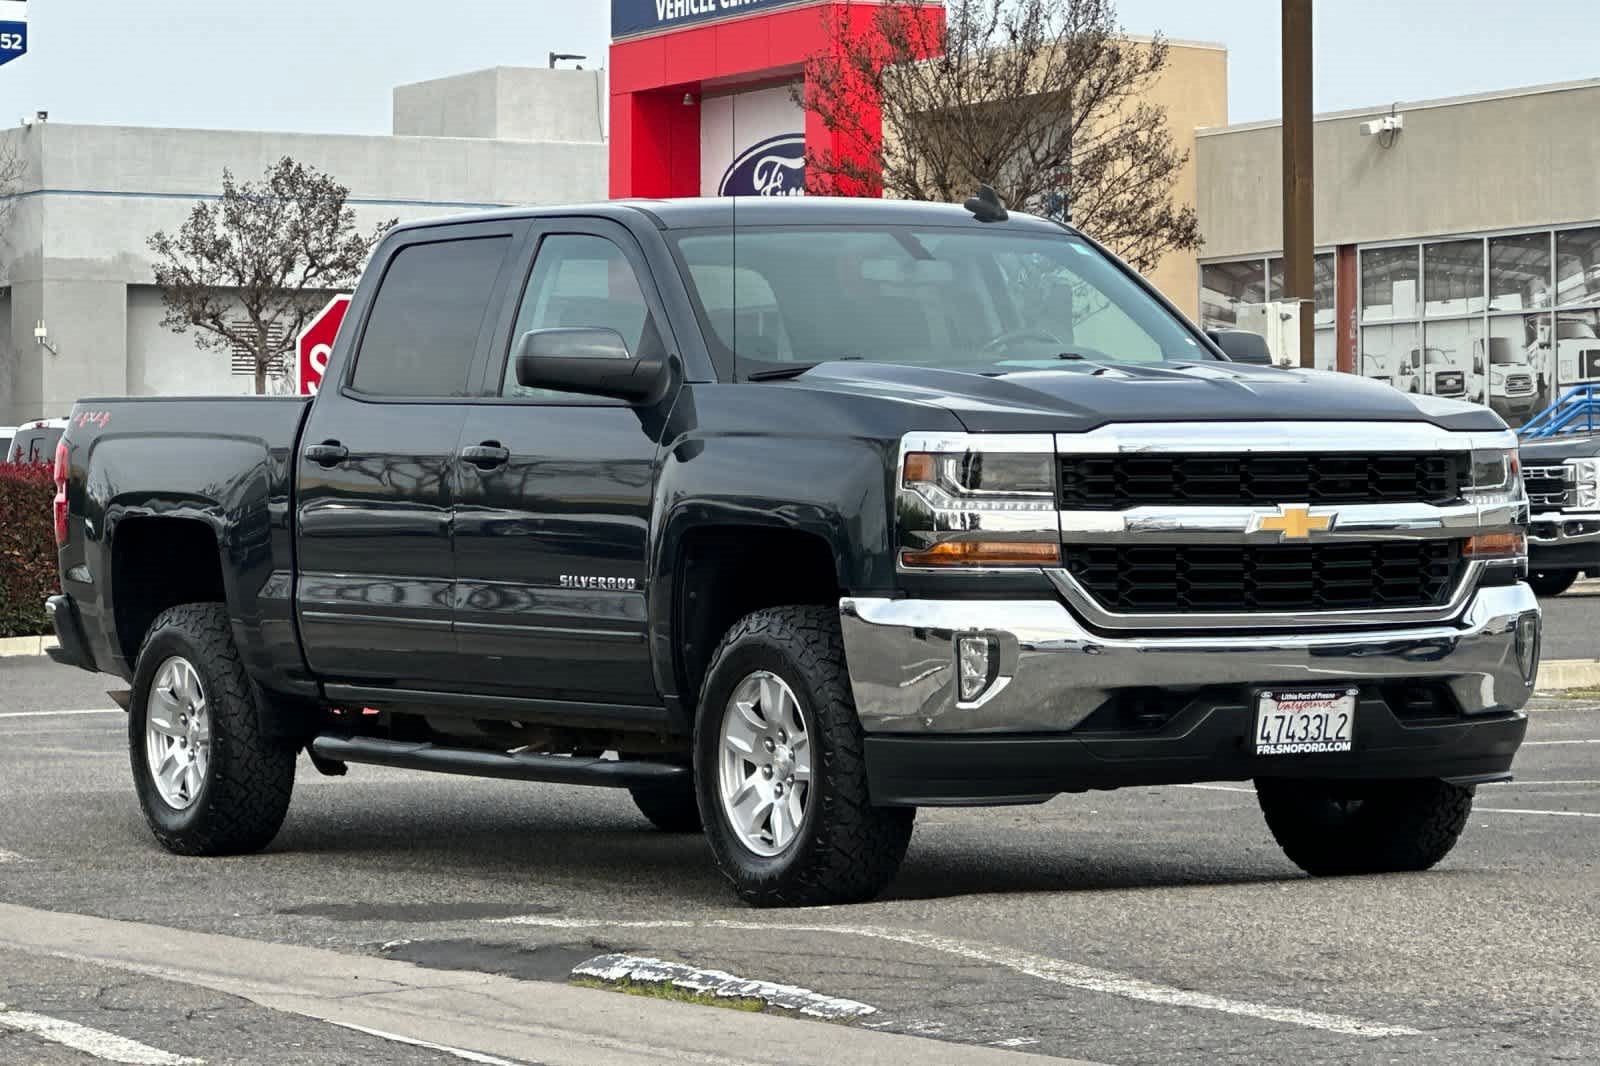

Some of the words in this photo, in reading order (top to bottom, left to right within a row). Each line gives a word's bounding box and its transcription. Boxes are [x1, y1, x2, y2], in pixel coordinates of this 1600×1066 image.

[559, 574, 636, 590] SILVERADO
[1260, 714, 1348, 742] 47433L2
[1256, 742, 1351, 754] FRESNOFORD.COM
